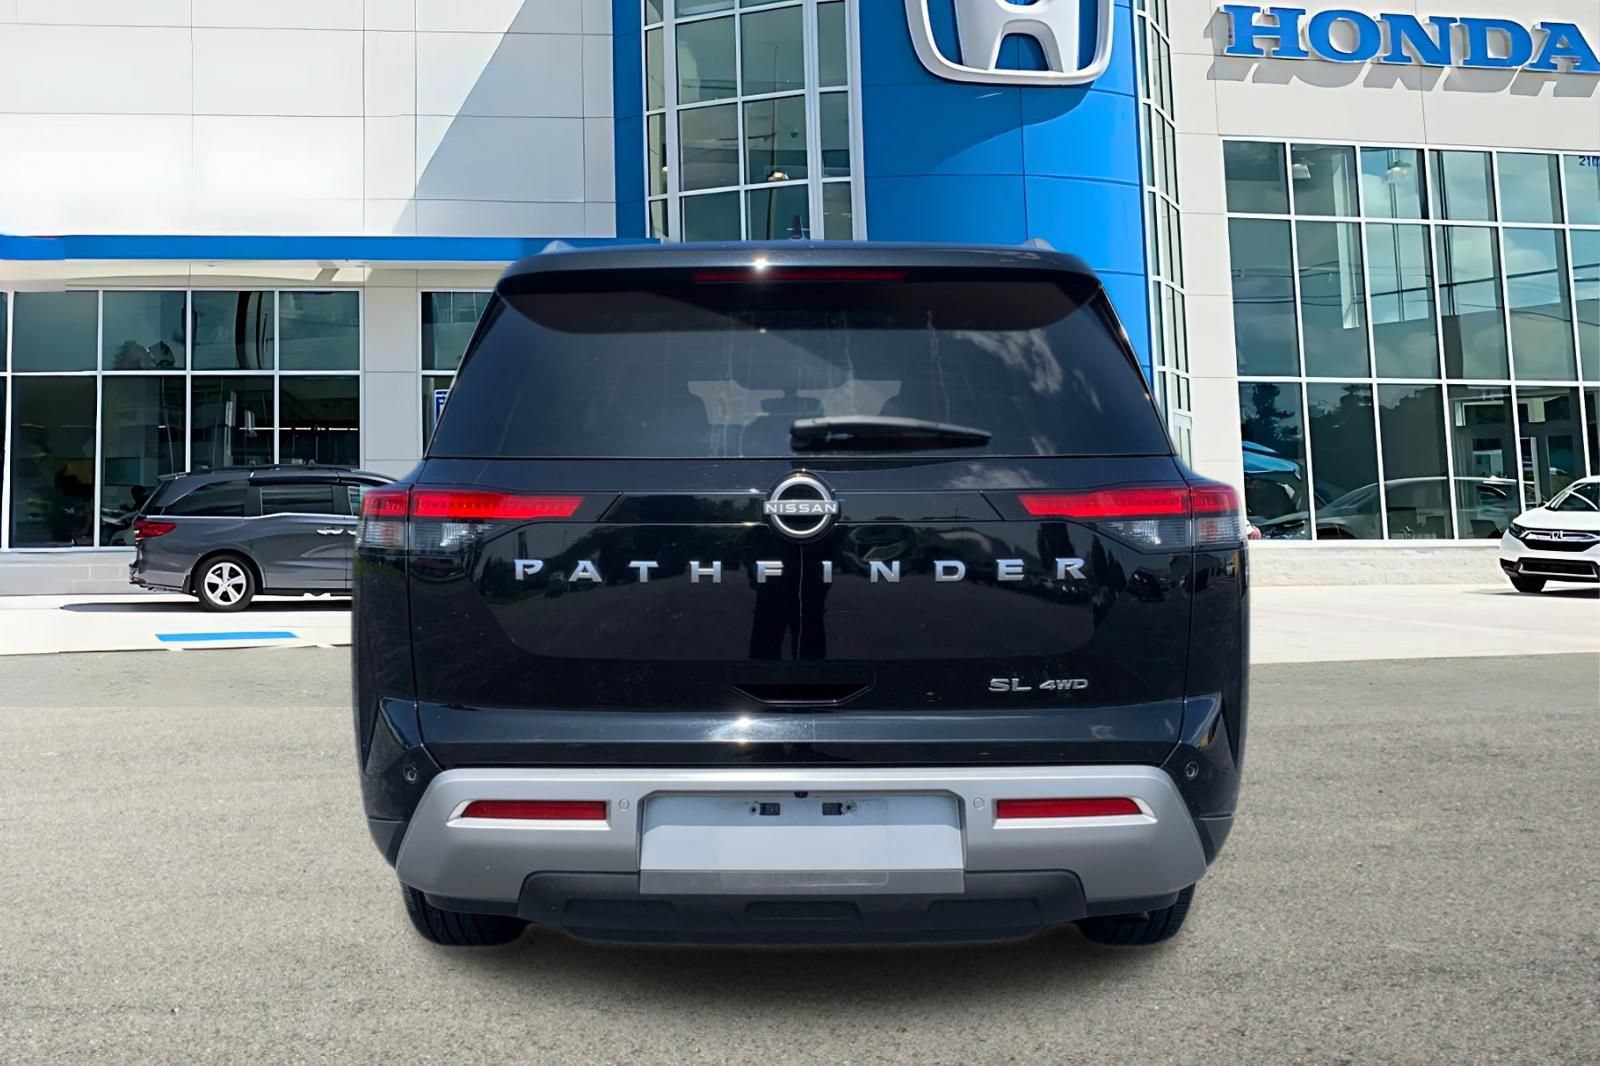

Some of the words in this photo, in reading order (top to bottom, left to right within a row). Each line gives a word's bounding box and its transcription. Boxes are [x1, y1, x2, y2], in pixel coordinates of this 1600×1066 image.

[1219, 4, 1600, 74] HONDA
[765, 503, 837, 513] NISSAN
[513, 557, 1087, 584] PATHFINDER
[988, 677, 1032, 692] SL
[1039, 678, 1089, 691] 4WD
